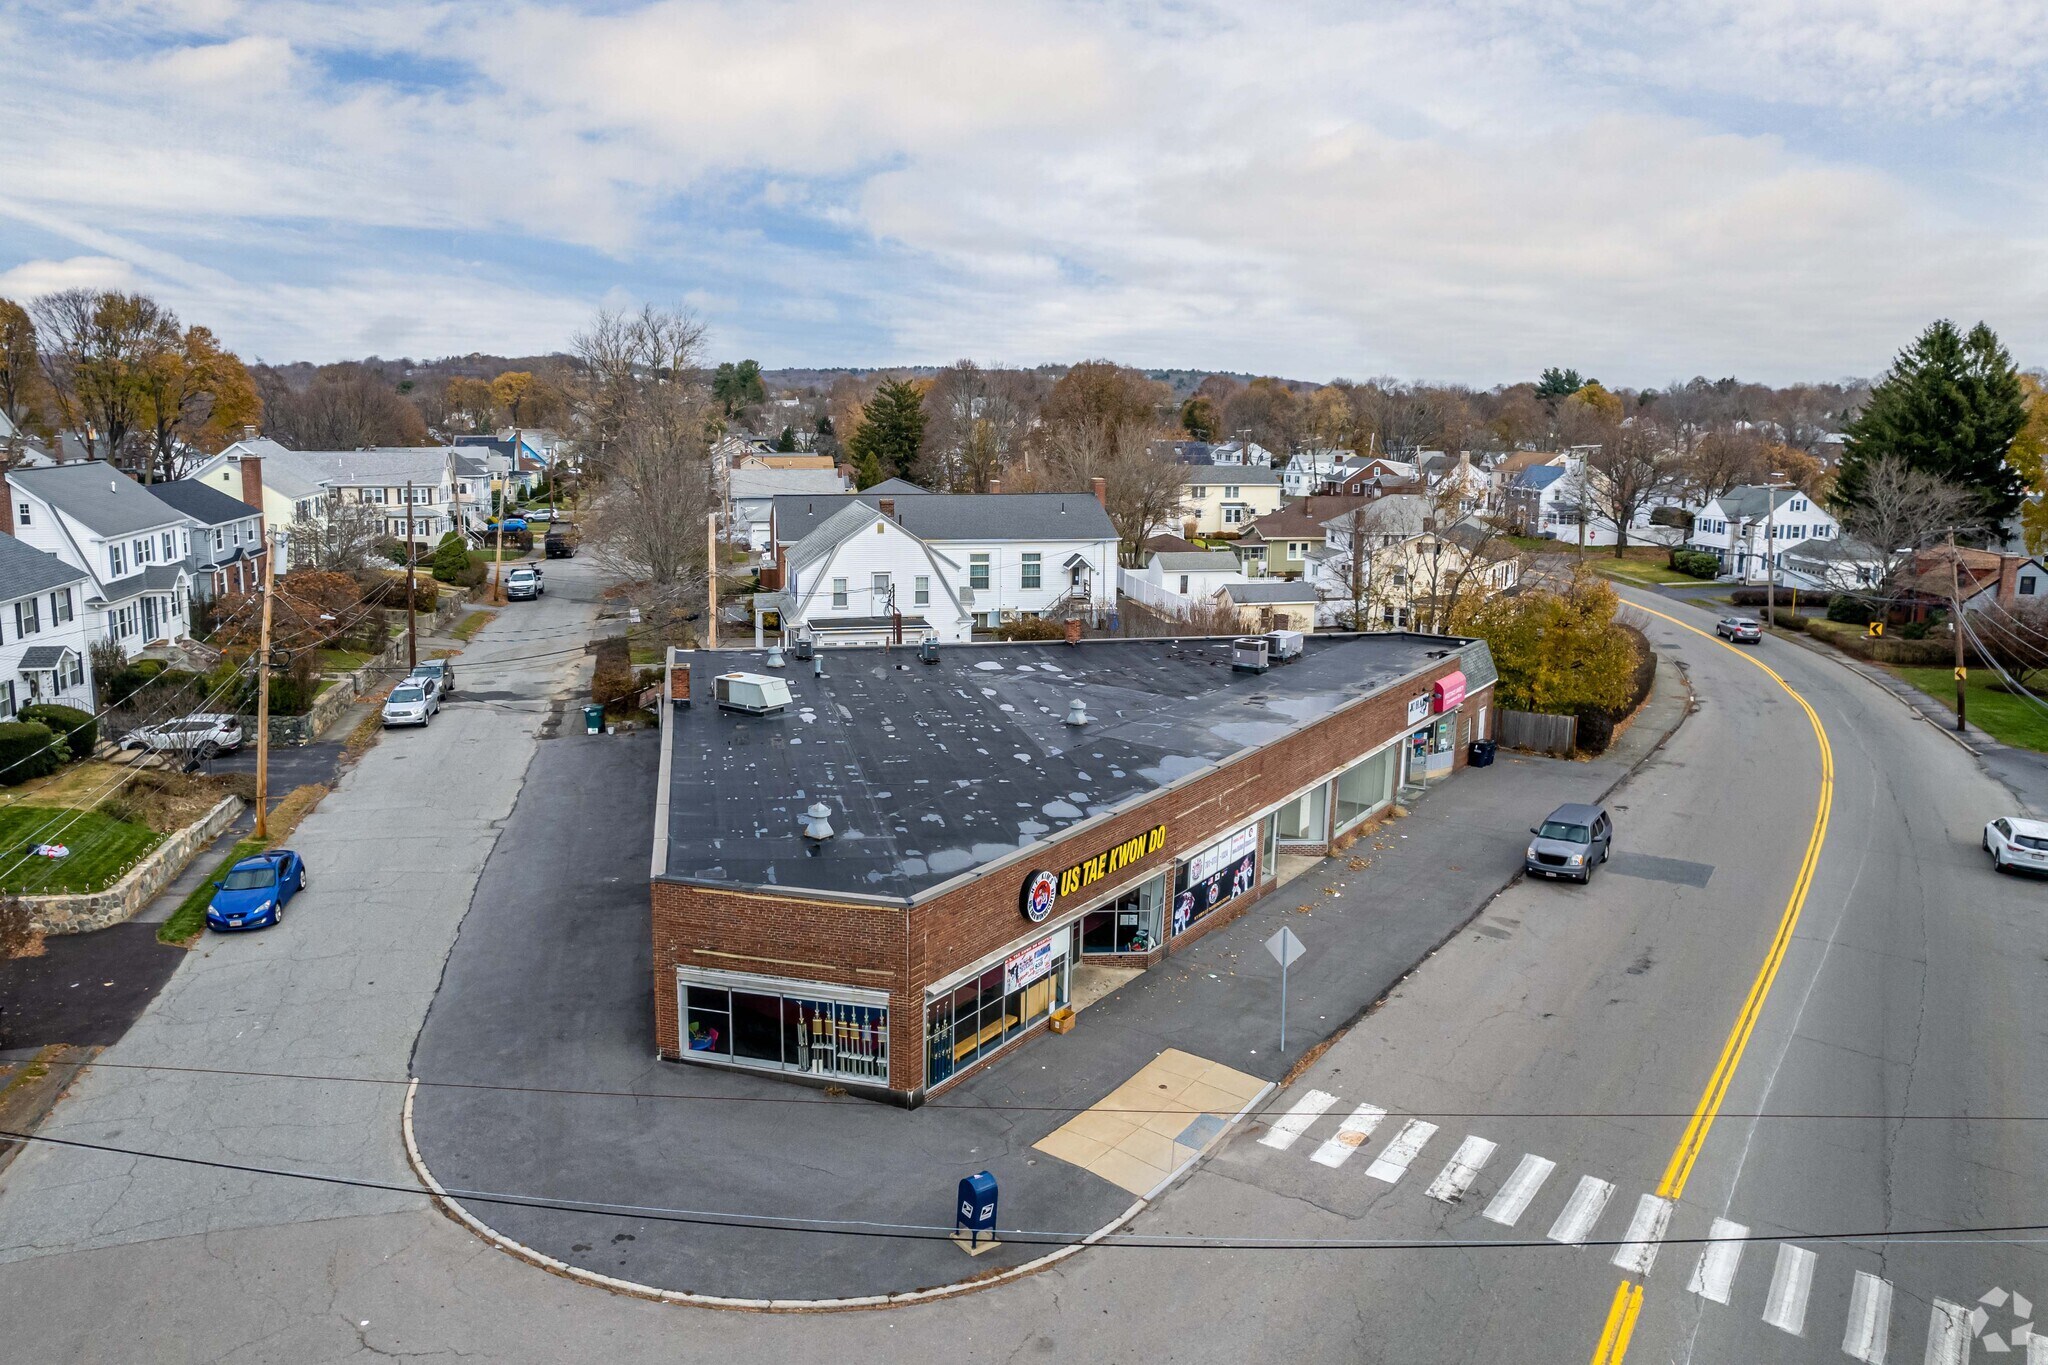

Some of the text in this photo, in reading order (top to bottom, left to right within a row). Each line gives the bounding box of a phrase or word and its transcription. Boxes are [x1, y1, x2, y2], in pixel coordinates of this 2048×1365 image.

[1060, 825, 1166, 897] US TAE KWON DO
